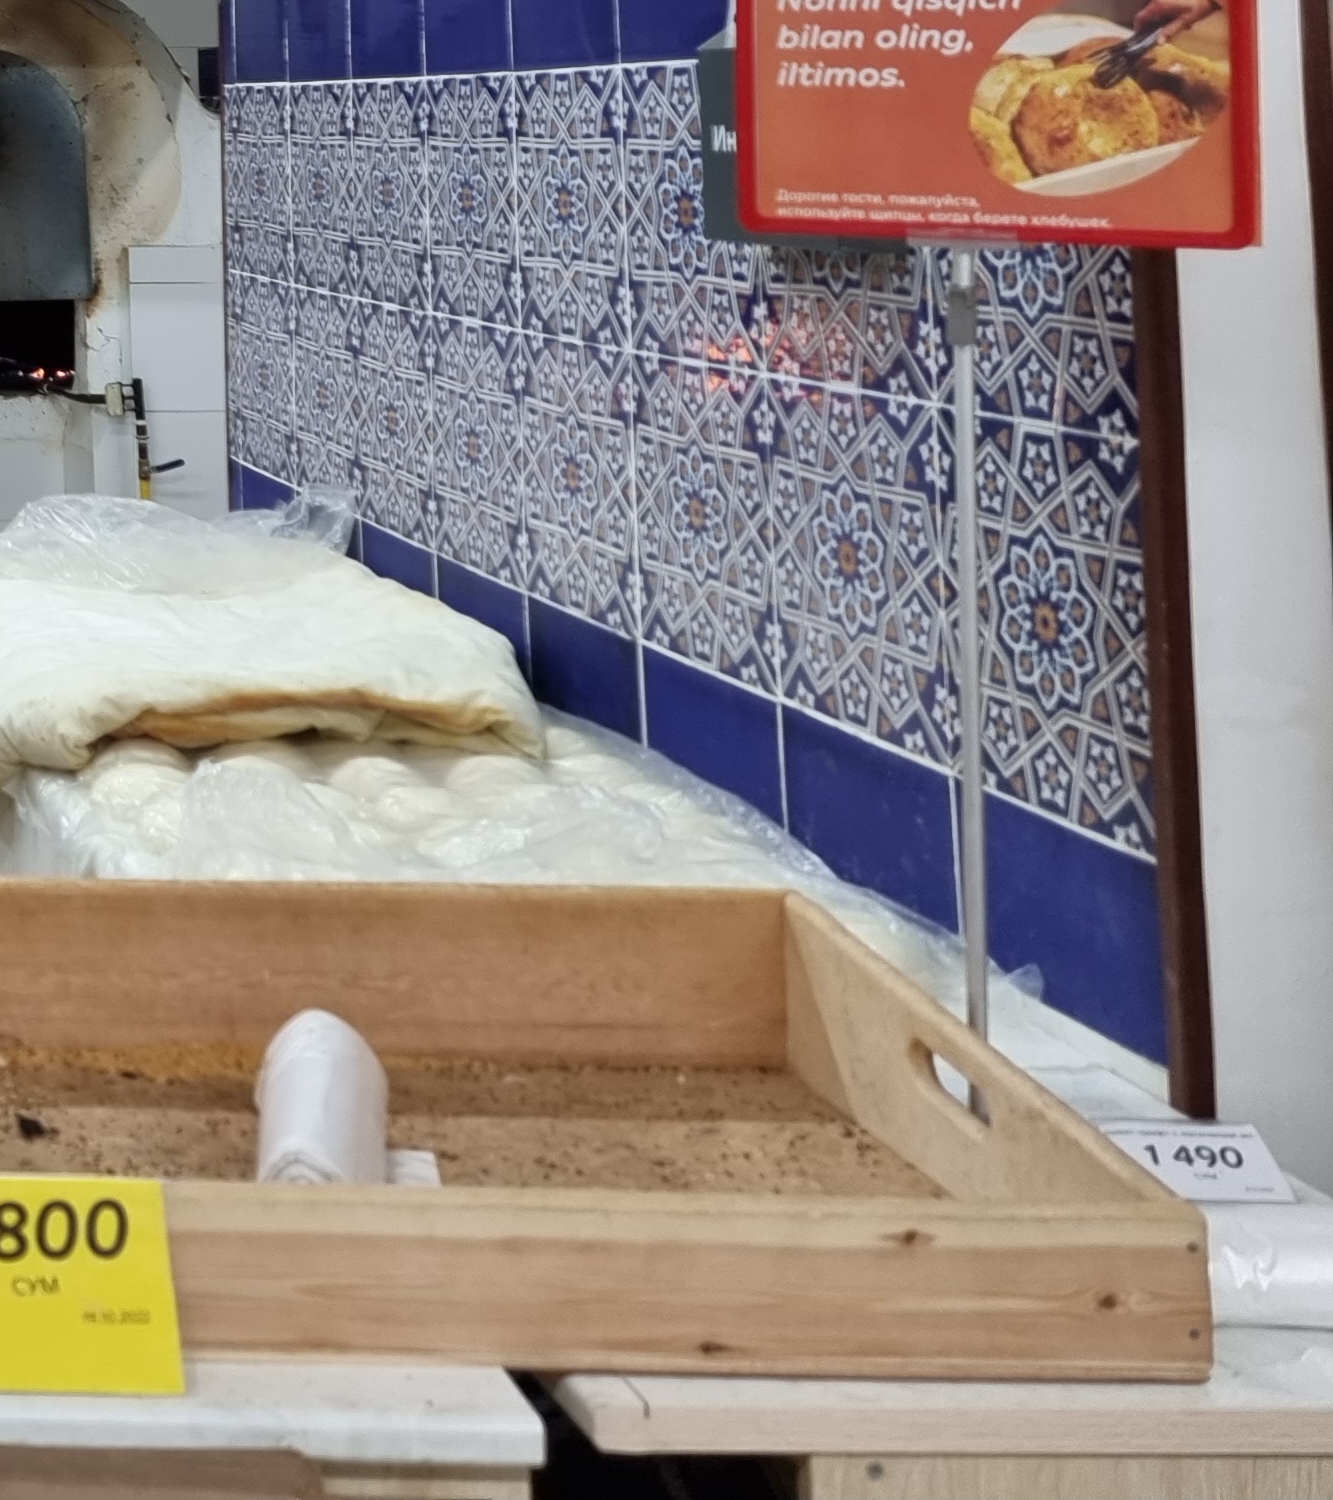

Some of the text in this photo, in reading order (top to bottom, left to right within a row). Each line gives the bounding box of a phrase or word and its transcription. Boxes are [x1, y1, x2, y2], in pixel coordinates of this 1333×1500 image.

[777, 23, 974, 56] bilan oling,
[777, 61, 906, 88] iltimos.
[1143, 1143, 1245, 1170] 1 490
